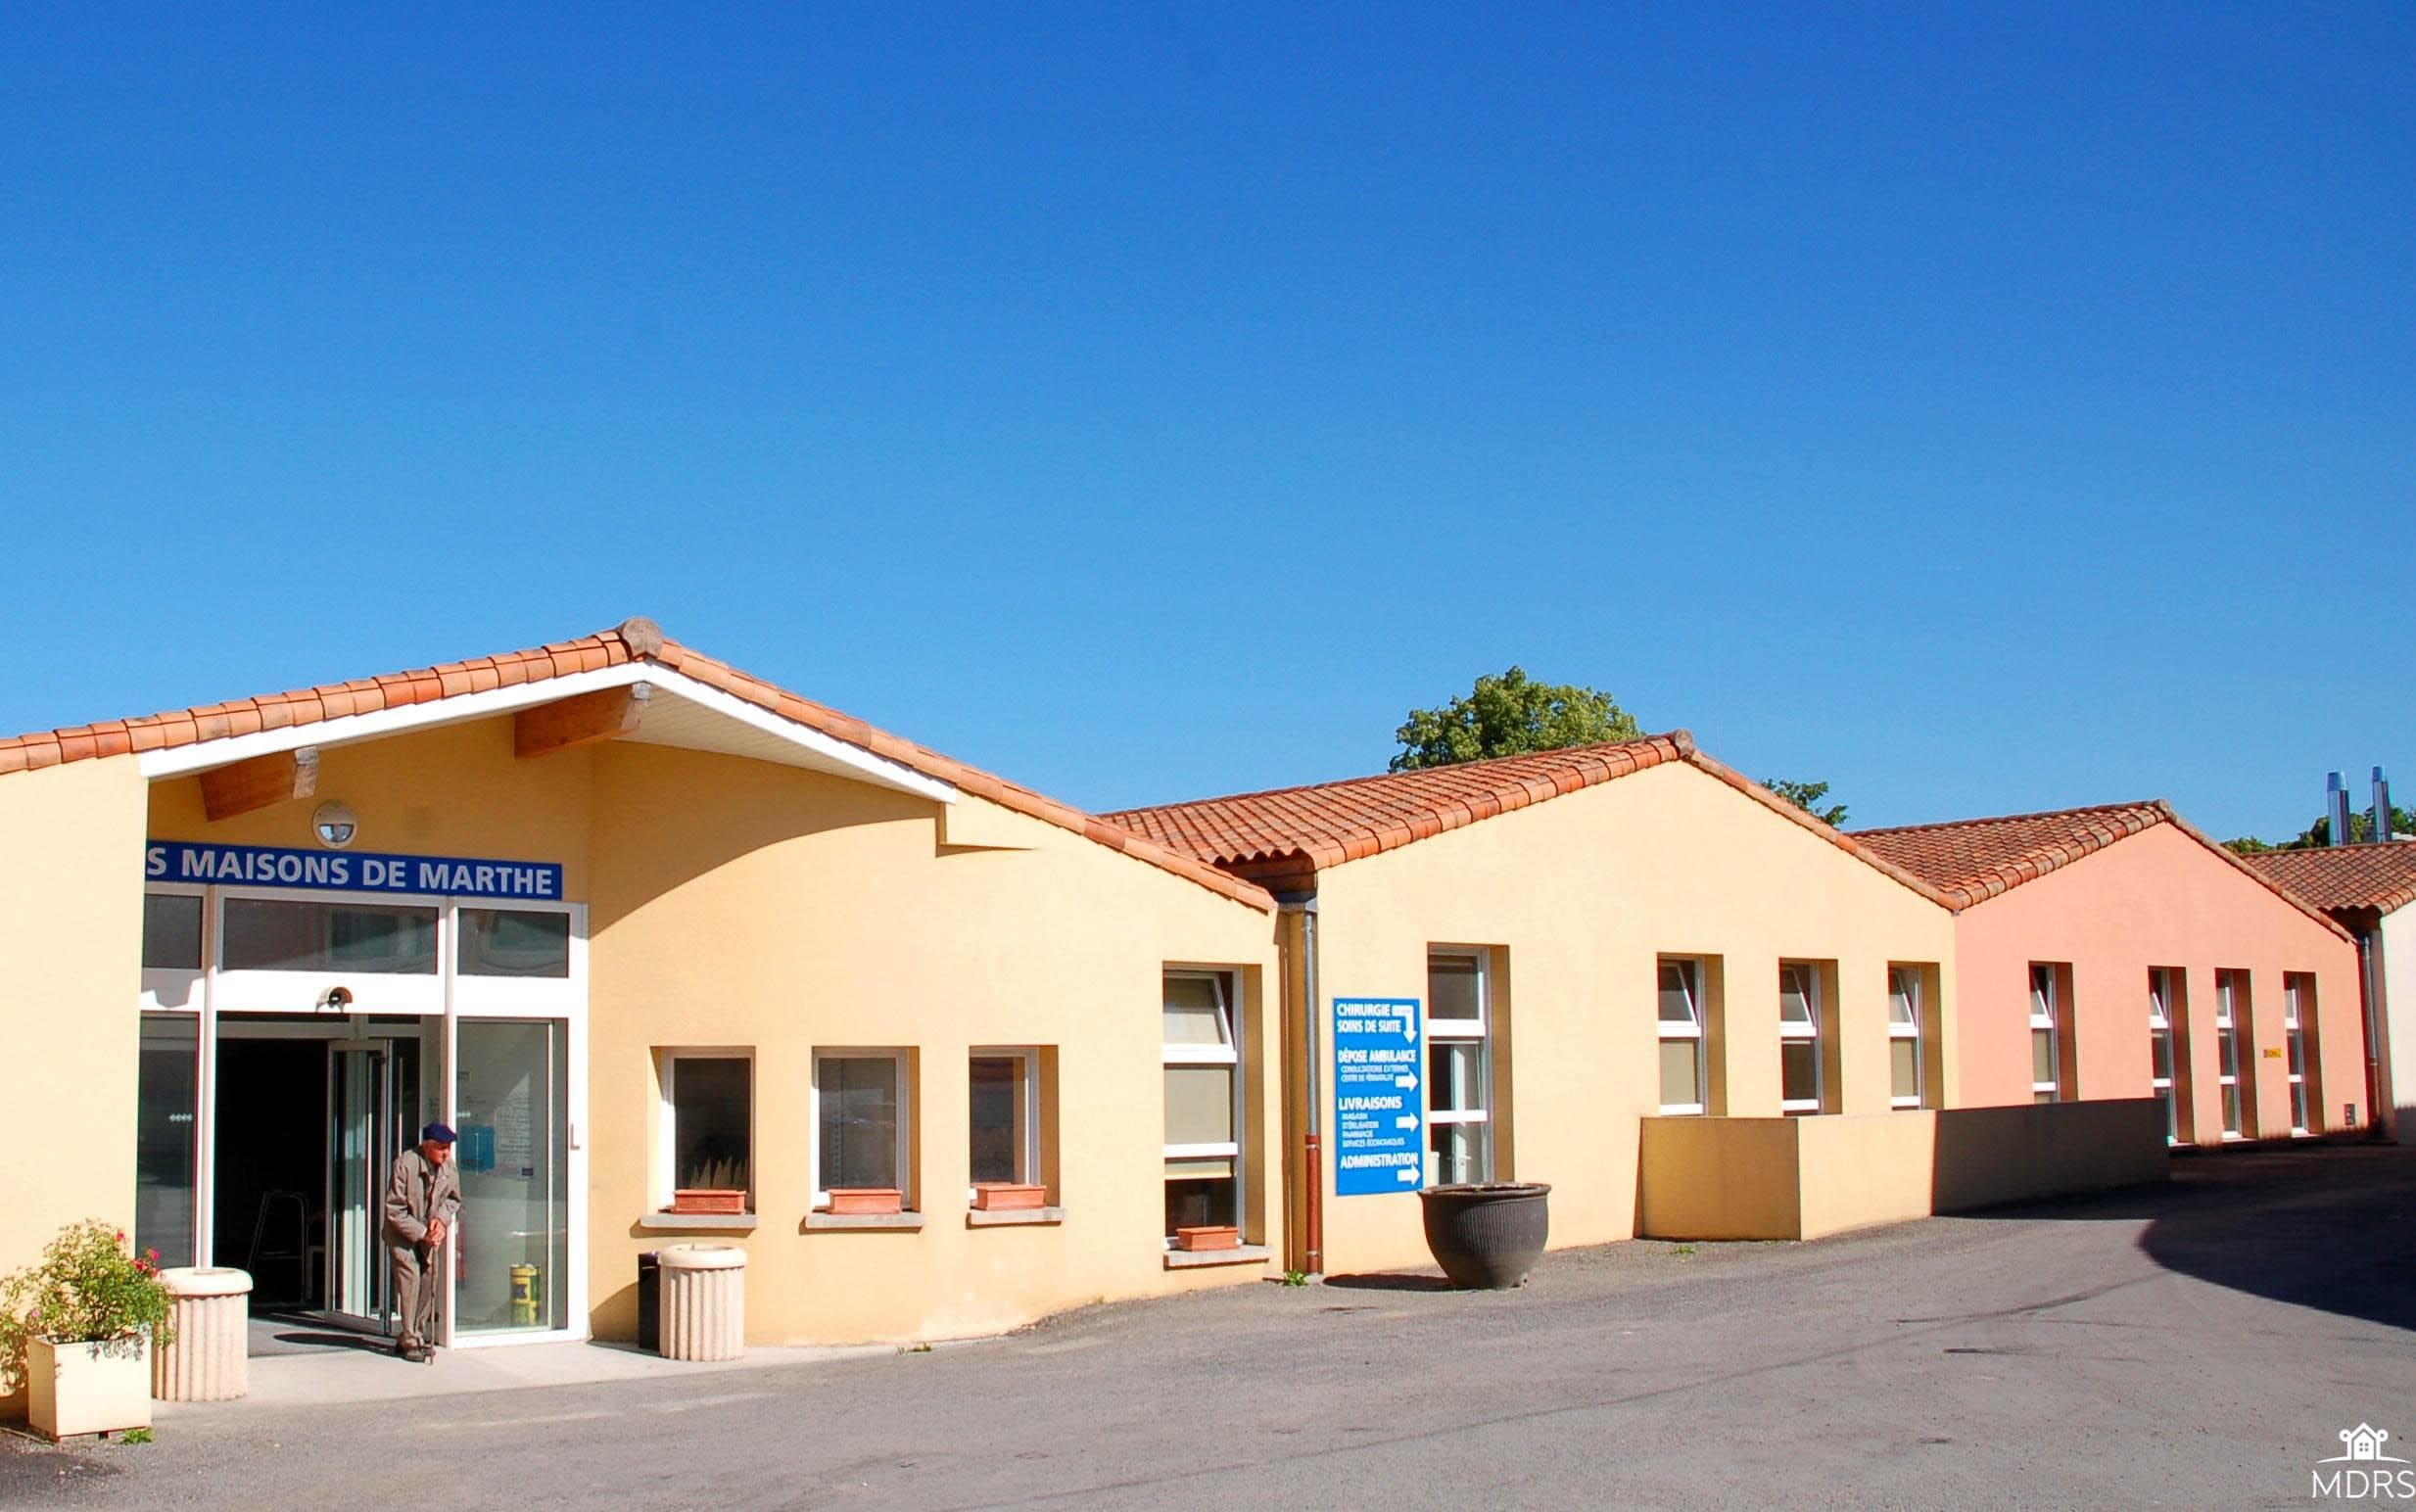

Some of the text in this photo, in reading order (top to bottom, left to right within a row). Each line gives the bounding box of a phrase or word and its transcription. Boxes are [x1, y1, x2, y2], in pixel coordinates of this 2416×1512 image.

[181, 848, 350, 885] MAISONS
[362, 859, 406, 888] DE
[419, 863, 553, 895] MARTHE
[1337, 1003, 1391, 1016] CHIRURGIE
[1337, 1019, 1401, 1033] SOINS DE SUITE
[1337, 1047, 1416, 1063] DÉPOSE AMBULANCE
[1339, 1096, 1403, 1110] LIVRAISONS
[1340, 1152, 1419, 1169] ADMINISTRATION
